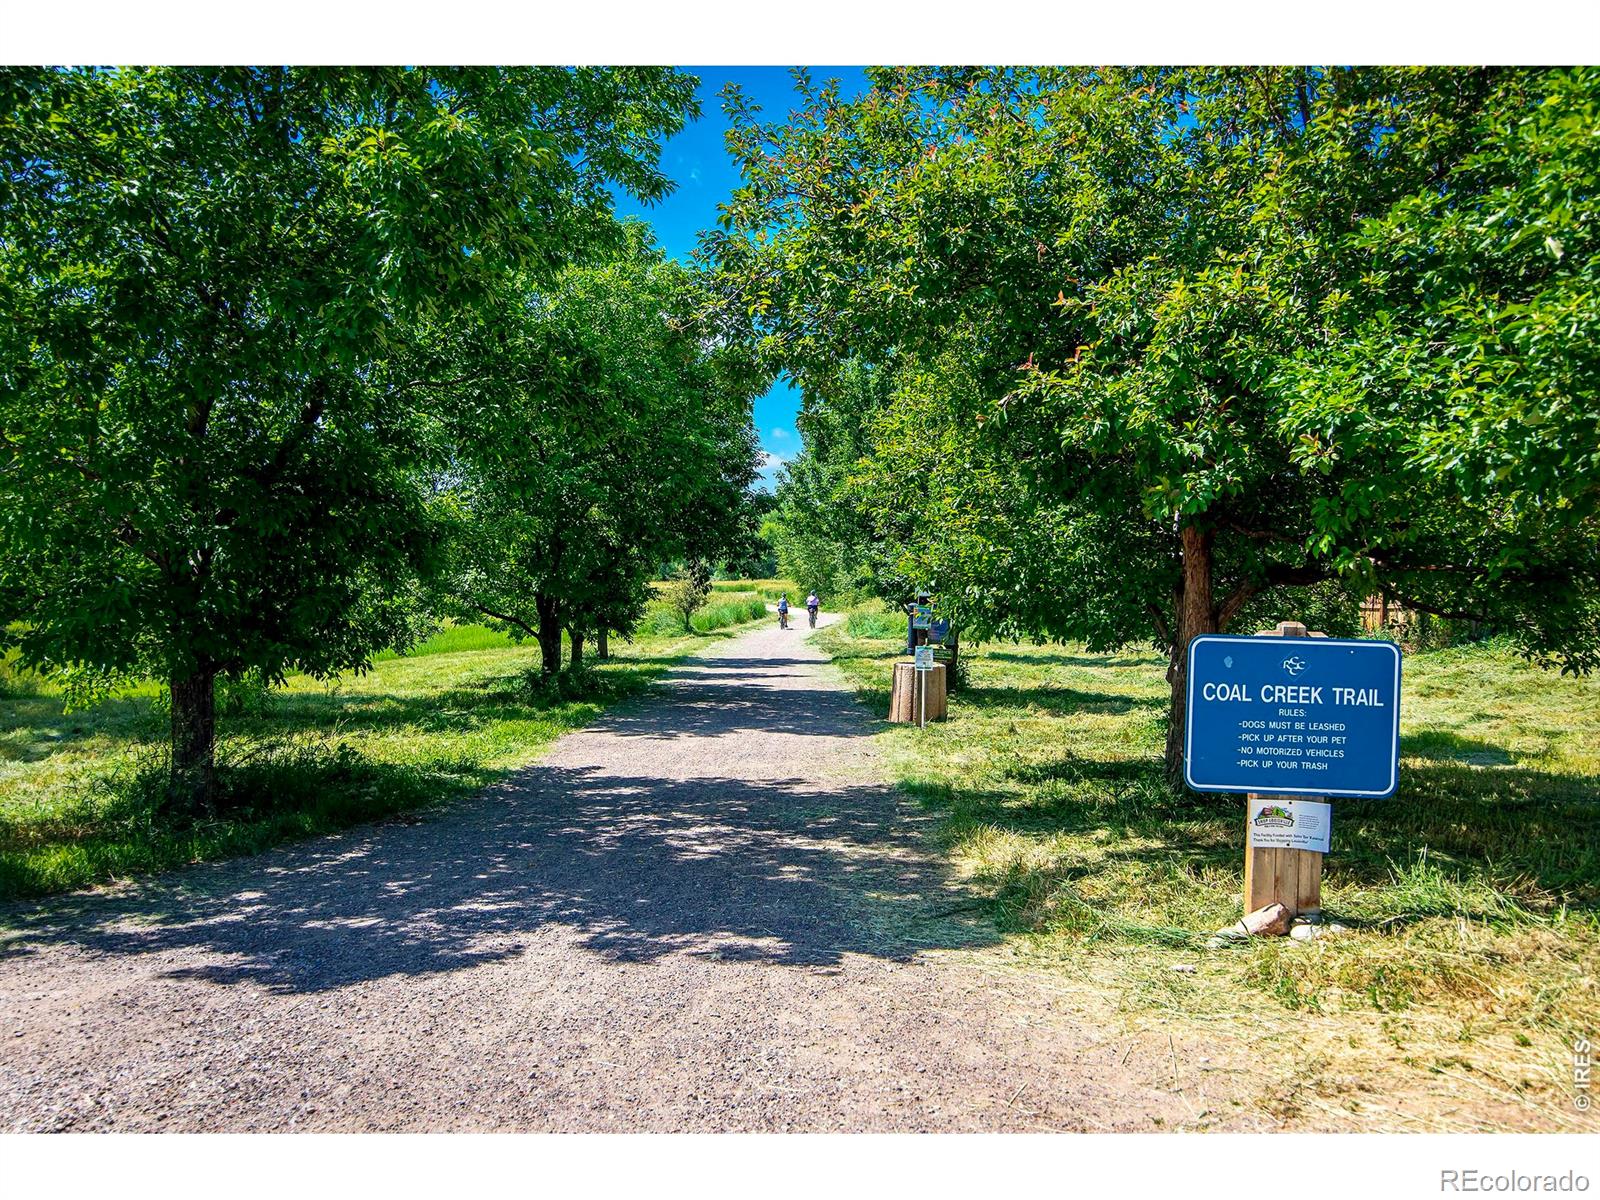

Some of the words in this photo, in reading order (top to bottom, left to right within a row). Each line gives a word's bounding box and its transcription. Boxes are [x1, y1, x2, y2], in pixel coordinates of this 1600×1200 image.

[1202, 682, 1252, 702] COAL
[1260, 685, 1324, 704] CREEK
[1332, 687, 1384, 707] TRAIL
[1278, 708, 1307, 717] RULES:
[1238, 721, 1266, 729] -DOGS
[1268, 721, 1292, 730] MUST
[1294, 722, 1305, 730] BE
[1308, 722, 1346, 731] LEASHED
[1237, 733, 1260, 742] -PICK
[1263, 734, 1275, 742] UP
[1277, 735, 1304, 743] AFTER
[1306, 735, 1328, 744] YOUR
[1331, 736, 1347, 745] PET
[1237, 746, 1253, 755] -NO
[1256, 747, 1303, 757] MOTORIZED
[1305, 749, 1345, 758] VEHICLES
[1236, 759, 1259, 768] -PICK
[1262, 760, 1273, 768] UP
[1276, 760, 1298, 769] YOUR
[1301, 761, 1328, 770] TRASH
